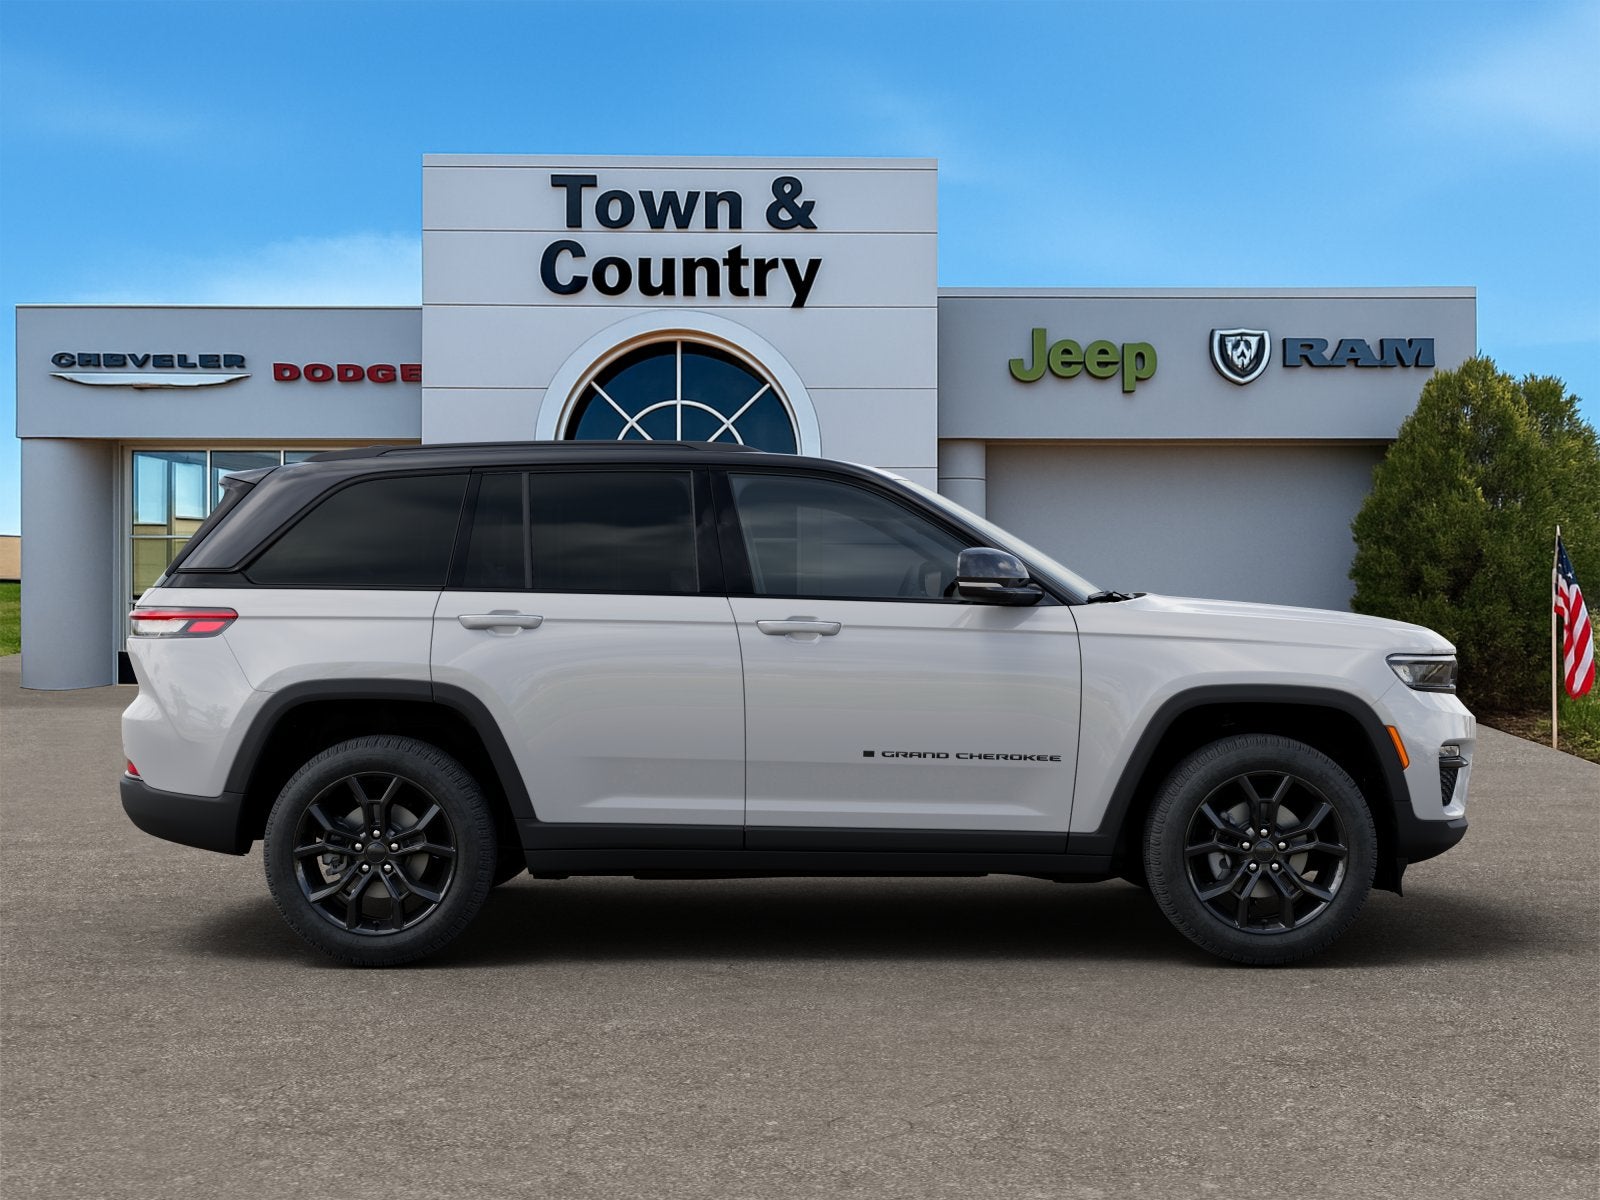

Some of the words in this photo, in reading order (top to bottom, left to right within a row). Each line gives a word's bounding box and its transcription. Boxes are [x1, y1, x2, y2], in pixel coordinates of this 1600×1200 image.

[551, 174, 742, 229] Town
[766, 176, 818, 230] &
[540, 239, 822, 308] Country
[273, 363, 422, 383] DODGE
[1009, 328, 1157, 392] Jeep
[1282, 337, 1435, 368] RAM
[881, 751, 949, 759] GRAND
[955, 752, 1062, 762] CHEROKEE
